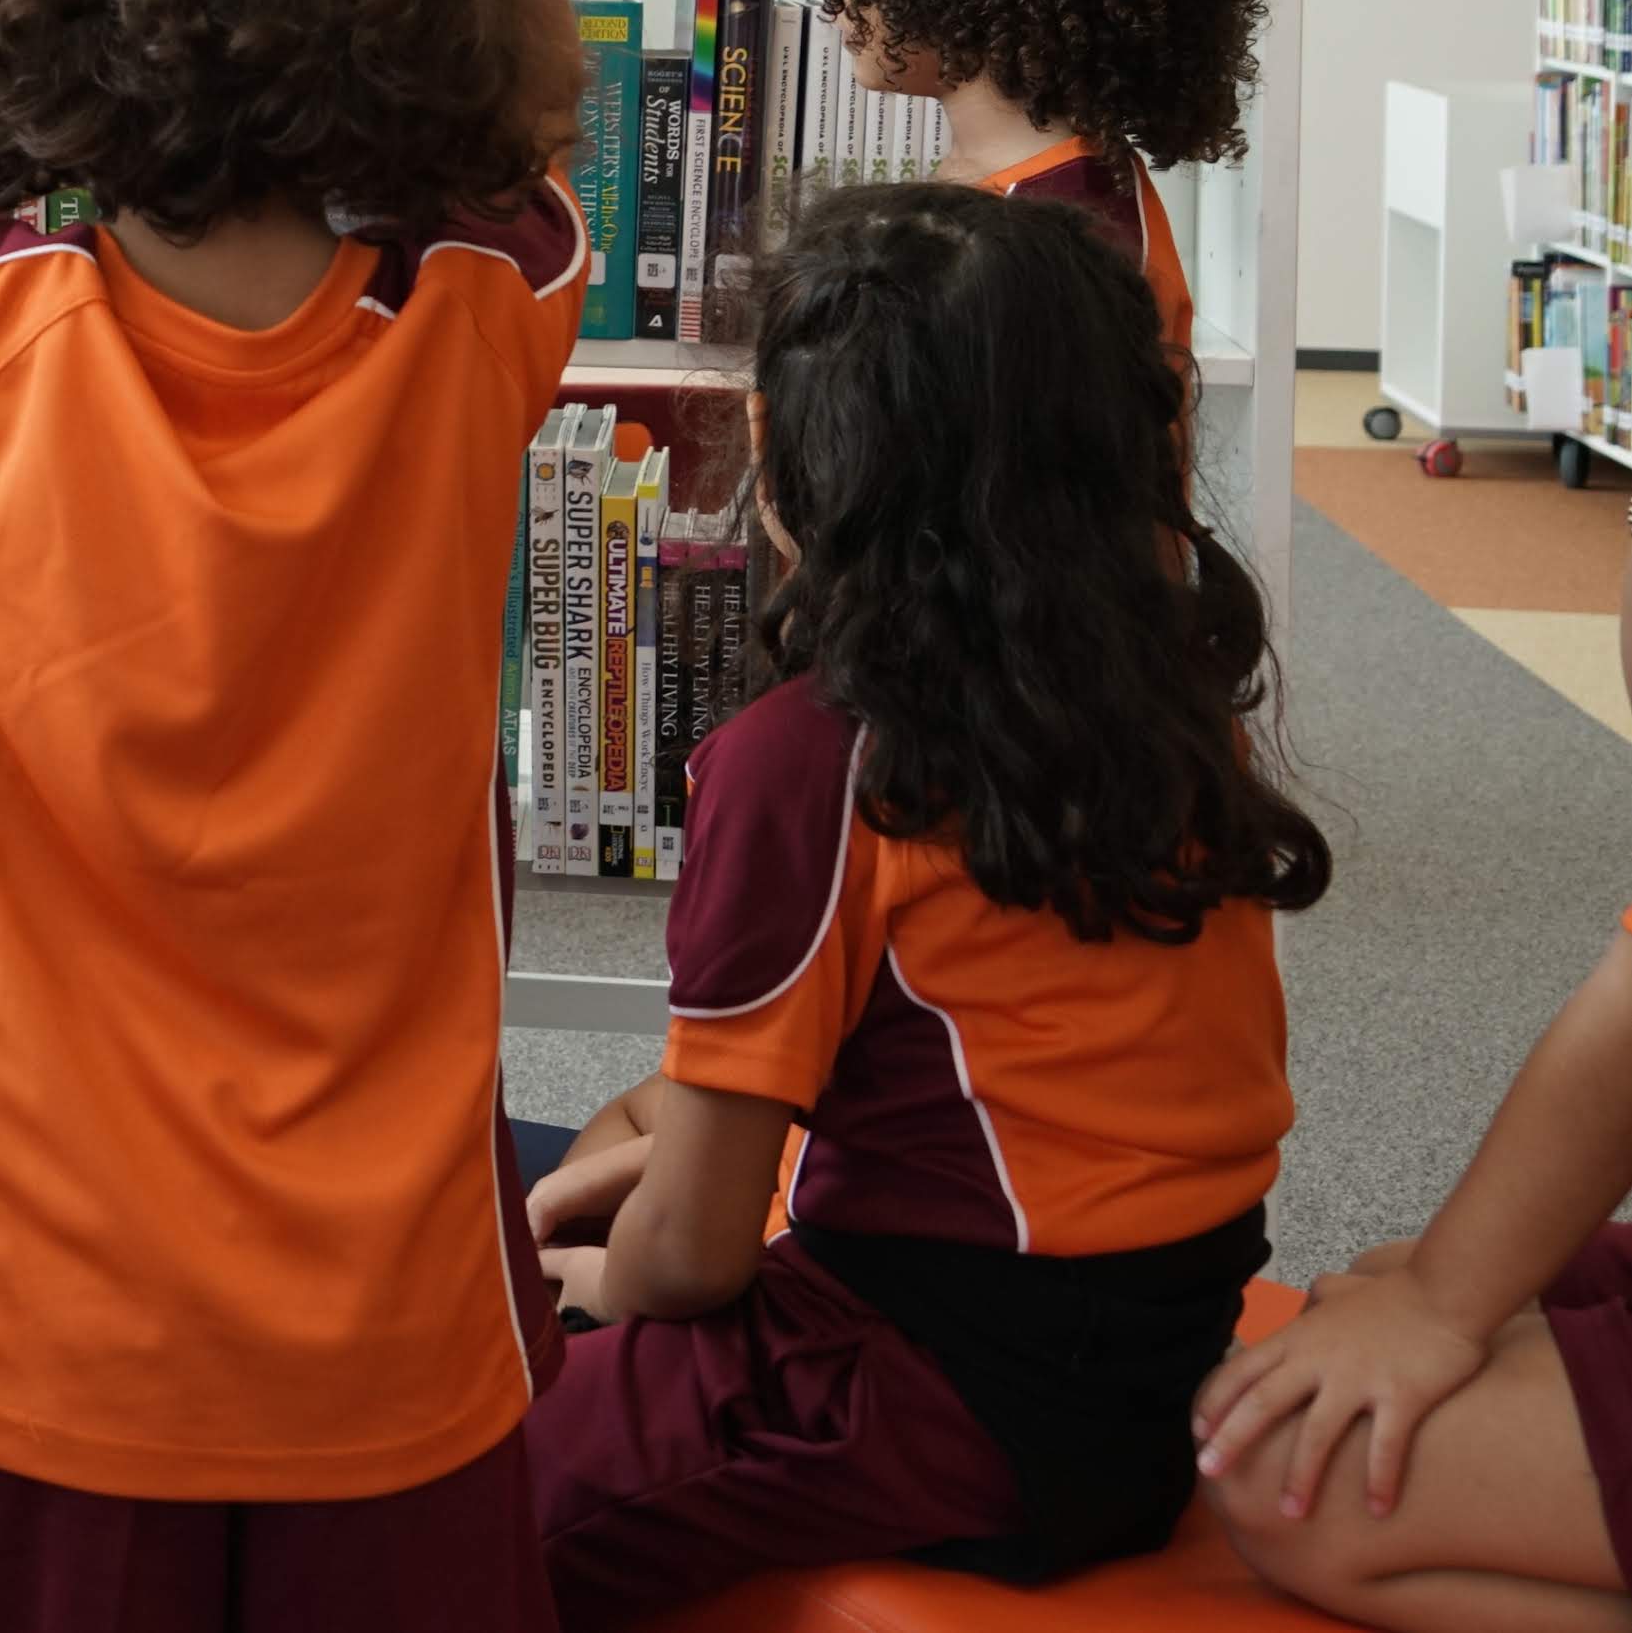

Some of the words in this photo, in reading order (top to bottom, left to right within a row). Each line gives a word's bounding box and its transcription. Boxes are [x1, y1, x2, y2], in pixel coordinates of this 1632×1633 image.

[581, 29, 626, 39] EDITION
[583, 19, 626, 28] SECOND
[602, 82, 622, 177] WEBSTER'S
[666, 100, 681, 160] WORDS
[694, 119, 706, 147] FIRST
[716, 46, 747, 173] SCIENCE
[778, 69, 788, 138] ENCYCLOPEDIA
[818, 70, 828, 139] ENCYCLOPEDIA
[643, 95, 666, 184] Students
[778, 141, 784, 152] OF
[818, 142, 824, 153] OF
[847, 143, 853, 155] OF
[876, 144, 883, 156] OF
[905, 144, 911, 156] OF
[934, 144, 940, 156] OF
[692, 152, 705, 195] SCIENCE
[600, 181, 618, 254] All-In-One
[567, 491, 593, 569] SUPER
[532, 538, 560, 614] SUPER
[606, 538, 627, 636] ULTIMATE
[505, 587, 520, 658] Illustrated
[534, 622, 560, 670] BUG
[566, 576, 593, 660] SHARK
[662, 582, 679, 670] HEALTHY
[642, 662, 651, 686] How
[504, 709, 518, 756] ATLAS
[542, 678, 554, 790] ENCYCLOPEDI
[568, 701, 576, 739] CREATURES
[577, 668, 591, 779] ENCYCLOPEDIA
[604, 638, 627, 791] REPTILEOPEDIA
[639, 692, 650, 726] Things
[661, 673, 677, 736] LIVING
[692, 677, 708, 739] LIVING
[567, 760, 576, 778] DEEP
[641, 730, 650, 758] Work
